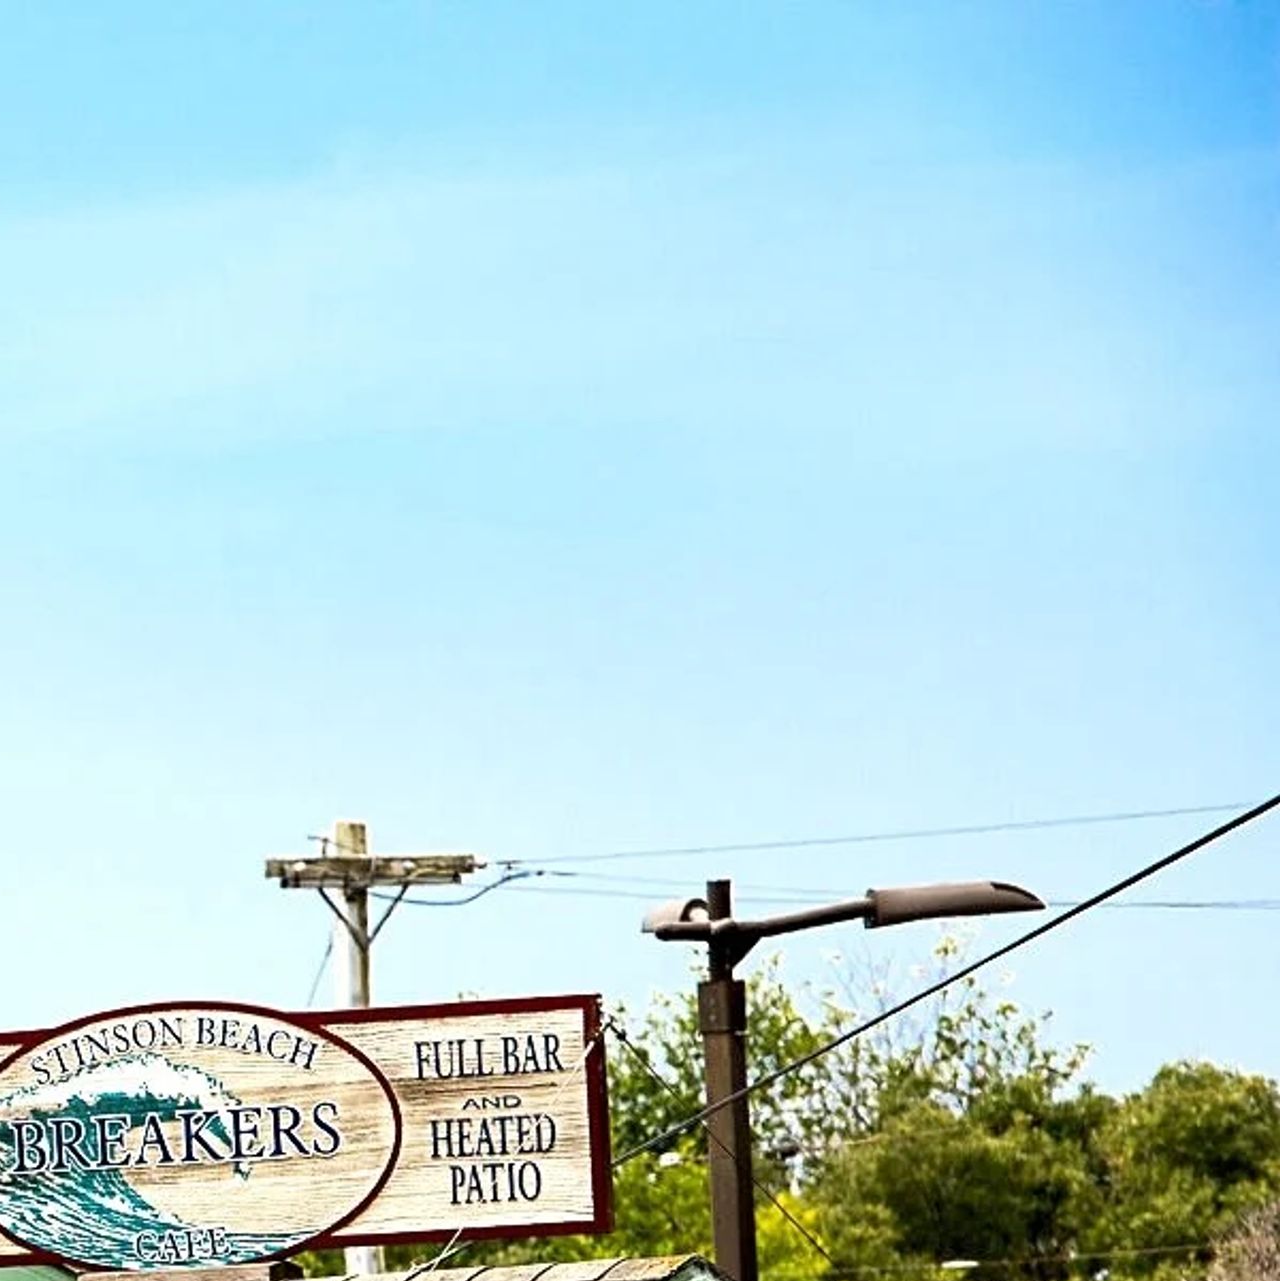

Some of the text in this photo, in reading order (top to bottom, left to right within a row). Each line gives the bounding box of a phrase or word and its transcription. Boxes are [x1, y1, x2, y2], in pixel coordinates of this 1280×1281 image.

[31, 1017, 318, 1085] STINSON BEACH
[415, 1034, 564, 1080] FULL BAR
[462, 1095, 521, 1110] AND
[11, 1102, 341, 1174] BREAKERS
[431, 1113, 556, 1158] HEATED
[450, 1161, 541, 1205] PATIO
[136, 1227, 231, 1261] CAFE
